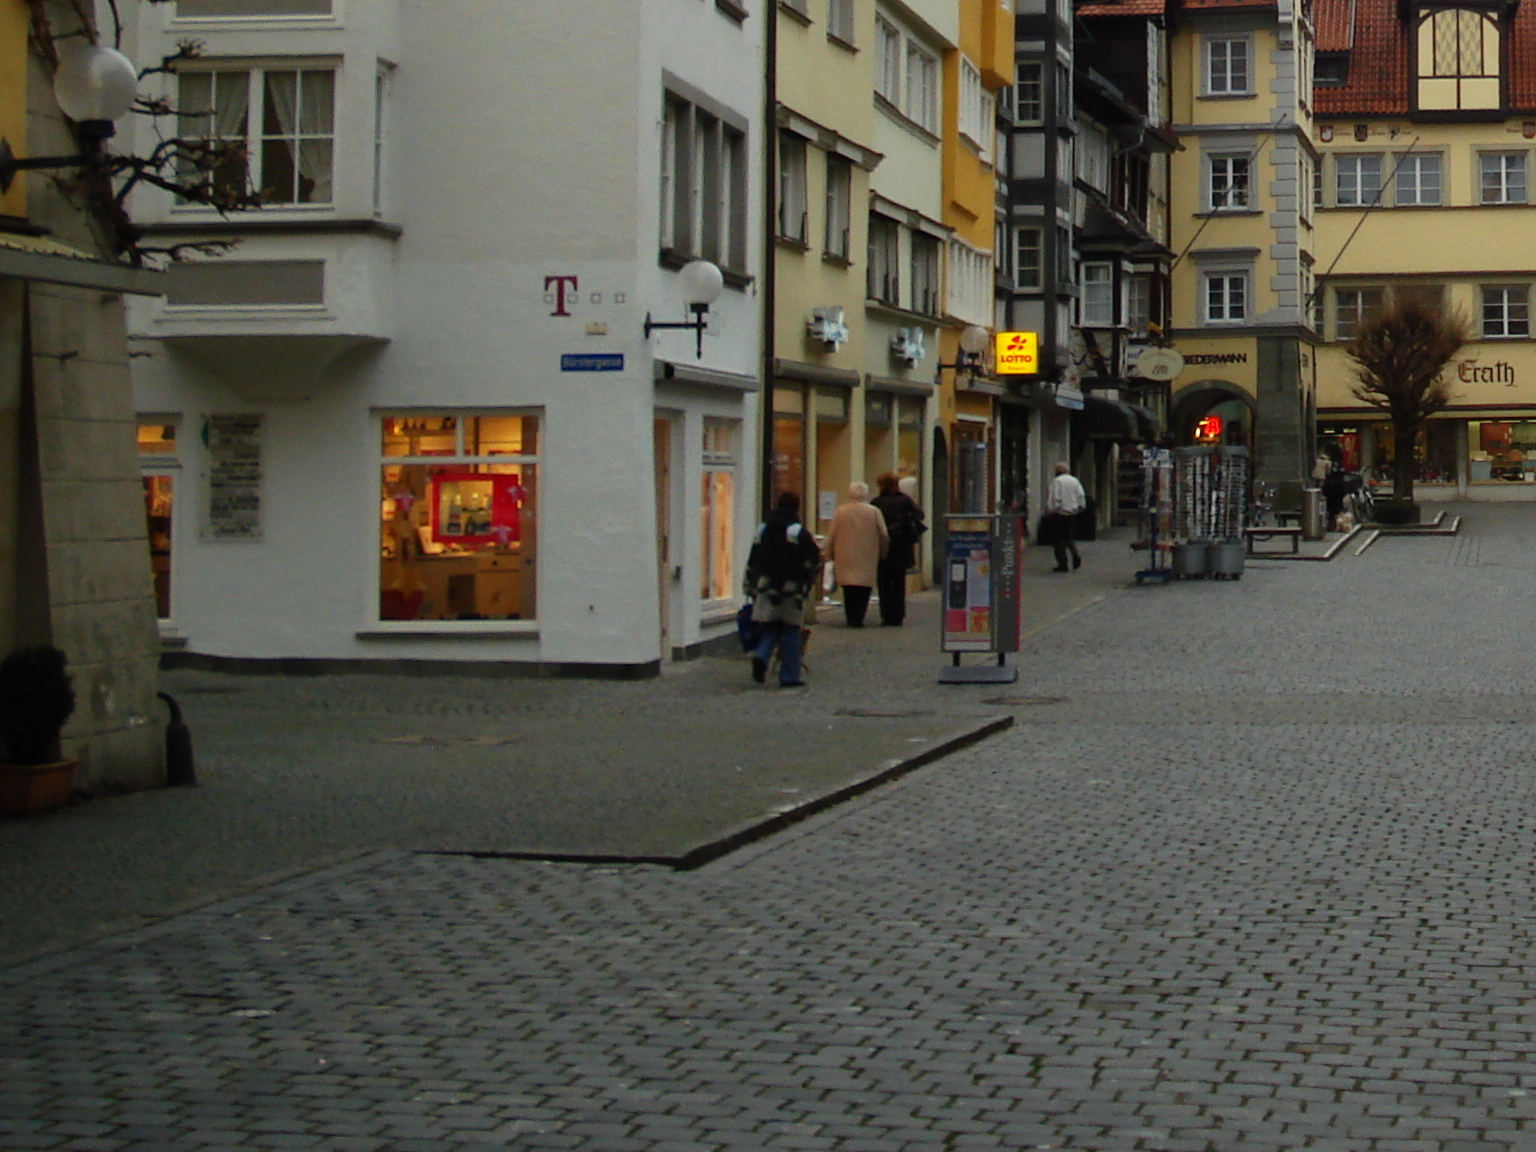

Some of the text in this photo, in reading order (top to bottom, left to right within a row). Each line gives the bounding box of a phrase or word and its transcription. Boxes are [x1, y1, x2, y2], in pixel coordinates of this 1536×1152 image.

[544, 275, 578, 317] T
[1001, 355, 1032, 363] LOTTO
[1458, 359, 1517, 387] Erath
